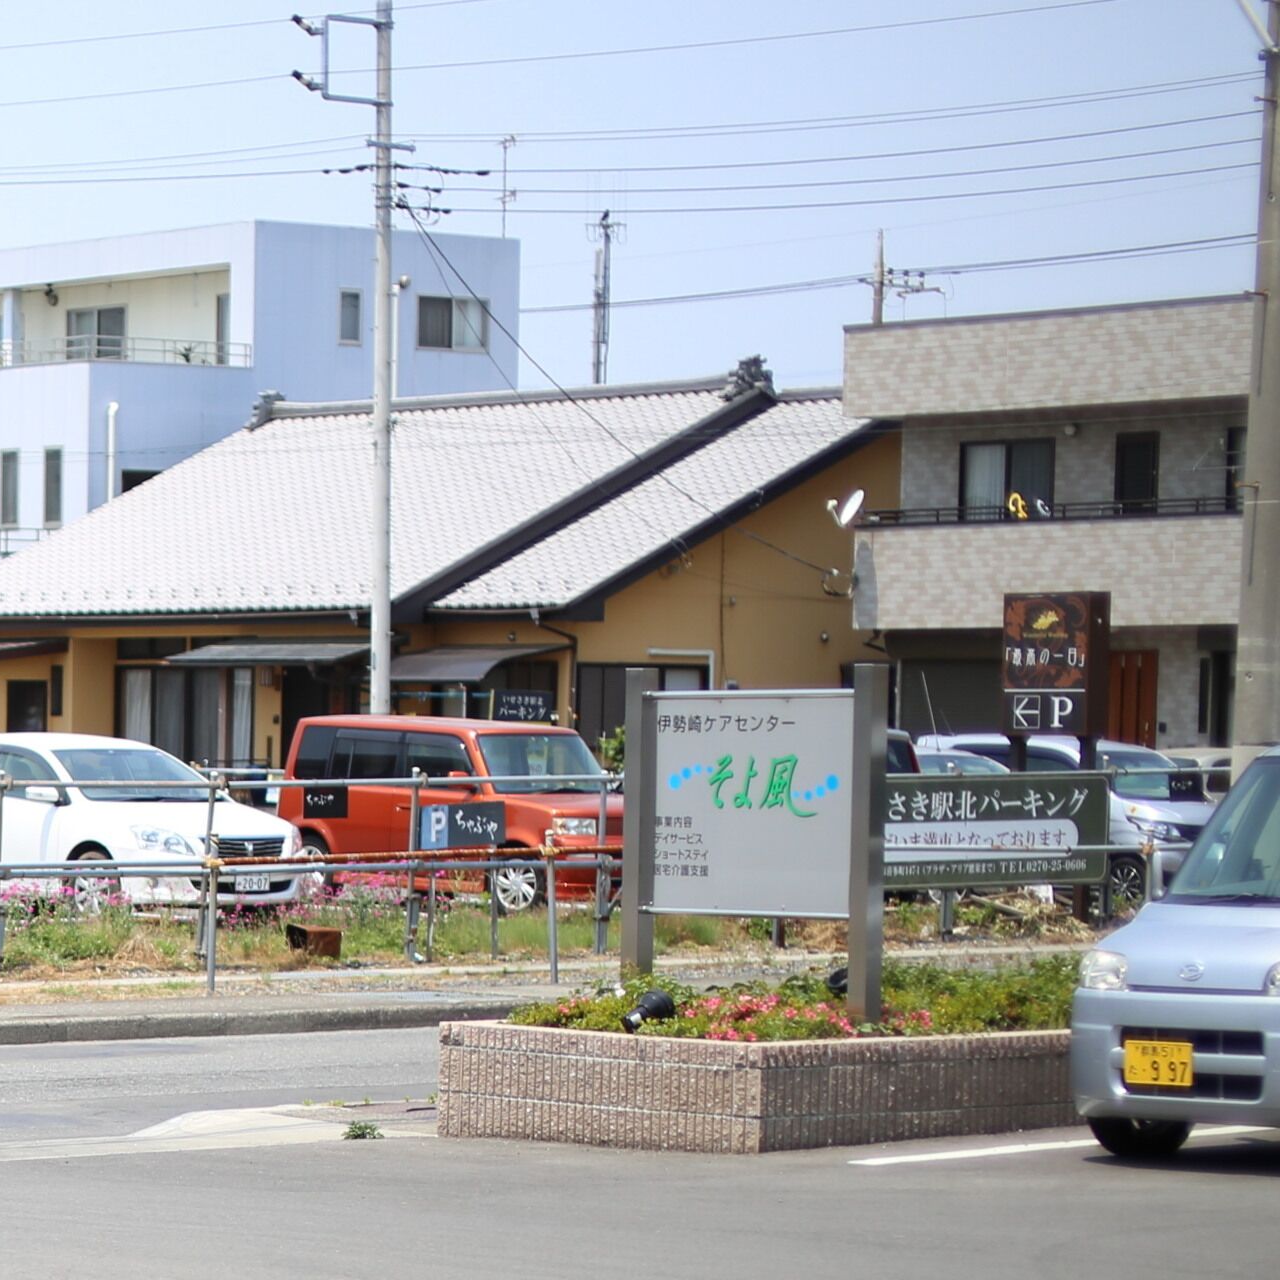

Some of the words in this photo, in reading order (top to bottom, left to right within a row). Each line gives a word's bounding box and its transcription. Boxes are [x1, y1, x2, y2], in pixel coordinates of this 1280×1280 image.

[499, 705, 547, 721] パーキング
[1049, 696, 1074, 728] P
[657, 714, 796, 733] 伊勢崎ケアセンター
[708, 753, 818, 818] そよ風
[888, 789, 1089, 820] さき駅北パーキング
[430, 810, 447, 843] P
[454, 809, 499, 841] ちゃぶや
[655, 816, 693, 828] 事業内容
[655, 833, 703, 844] デイサービス
[655, 849, 709, 861] ショートステイ
[655, 864, 709, 877] 居宅介護支援
[243, 877, 269, 890] 20-07
